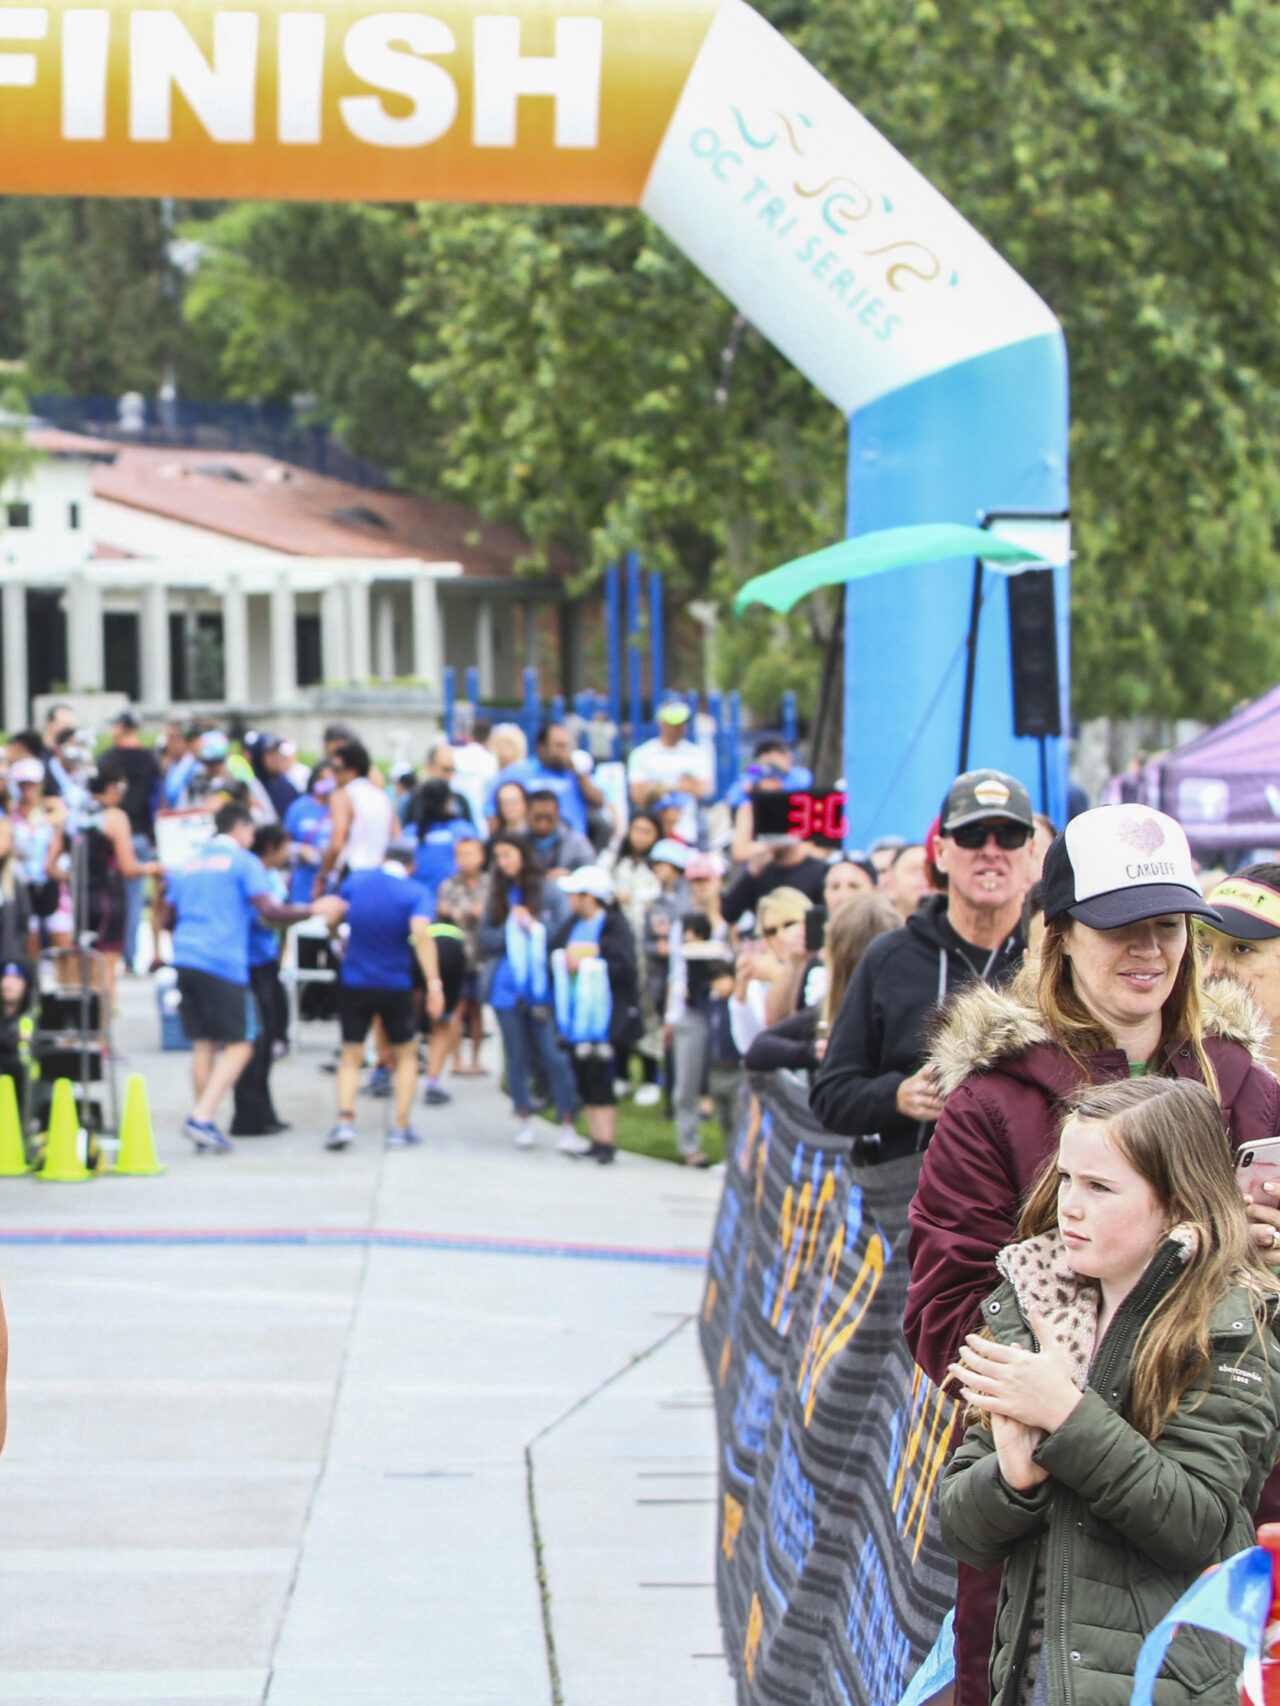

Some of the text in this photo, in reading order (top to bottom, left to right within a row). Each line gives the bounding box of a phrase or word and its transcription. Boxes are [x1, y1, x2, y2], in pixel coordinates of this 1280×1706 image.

[689, 126, 902, 341] OC TRI SERIES
[1125, 861, 1176, 879] CARDIFF
[1217, 1363, 1263, 1383] abercrombie
